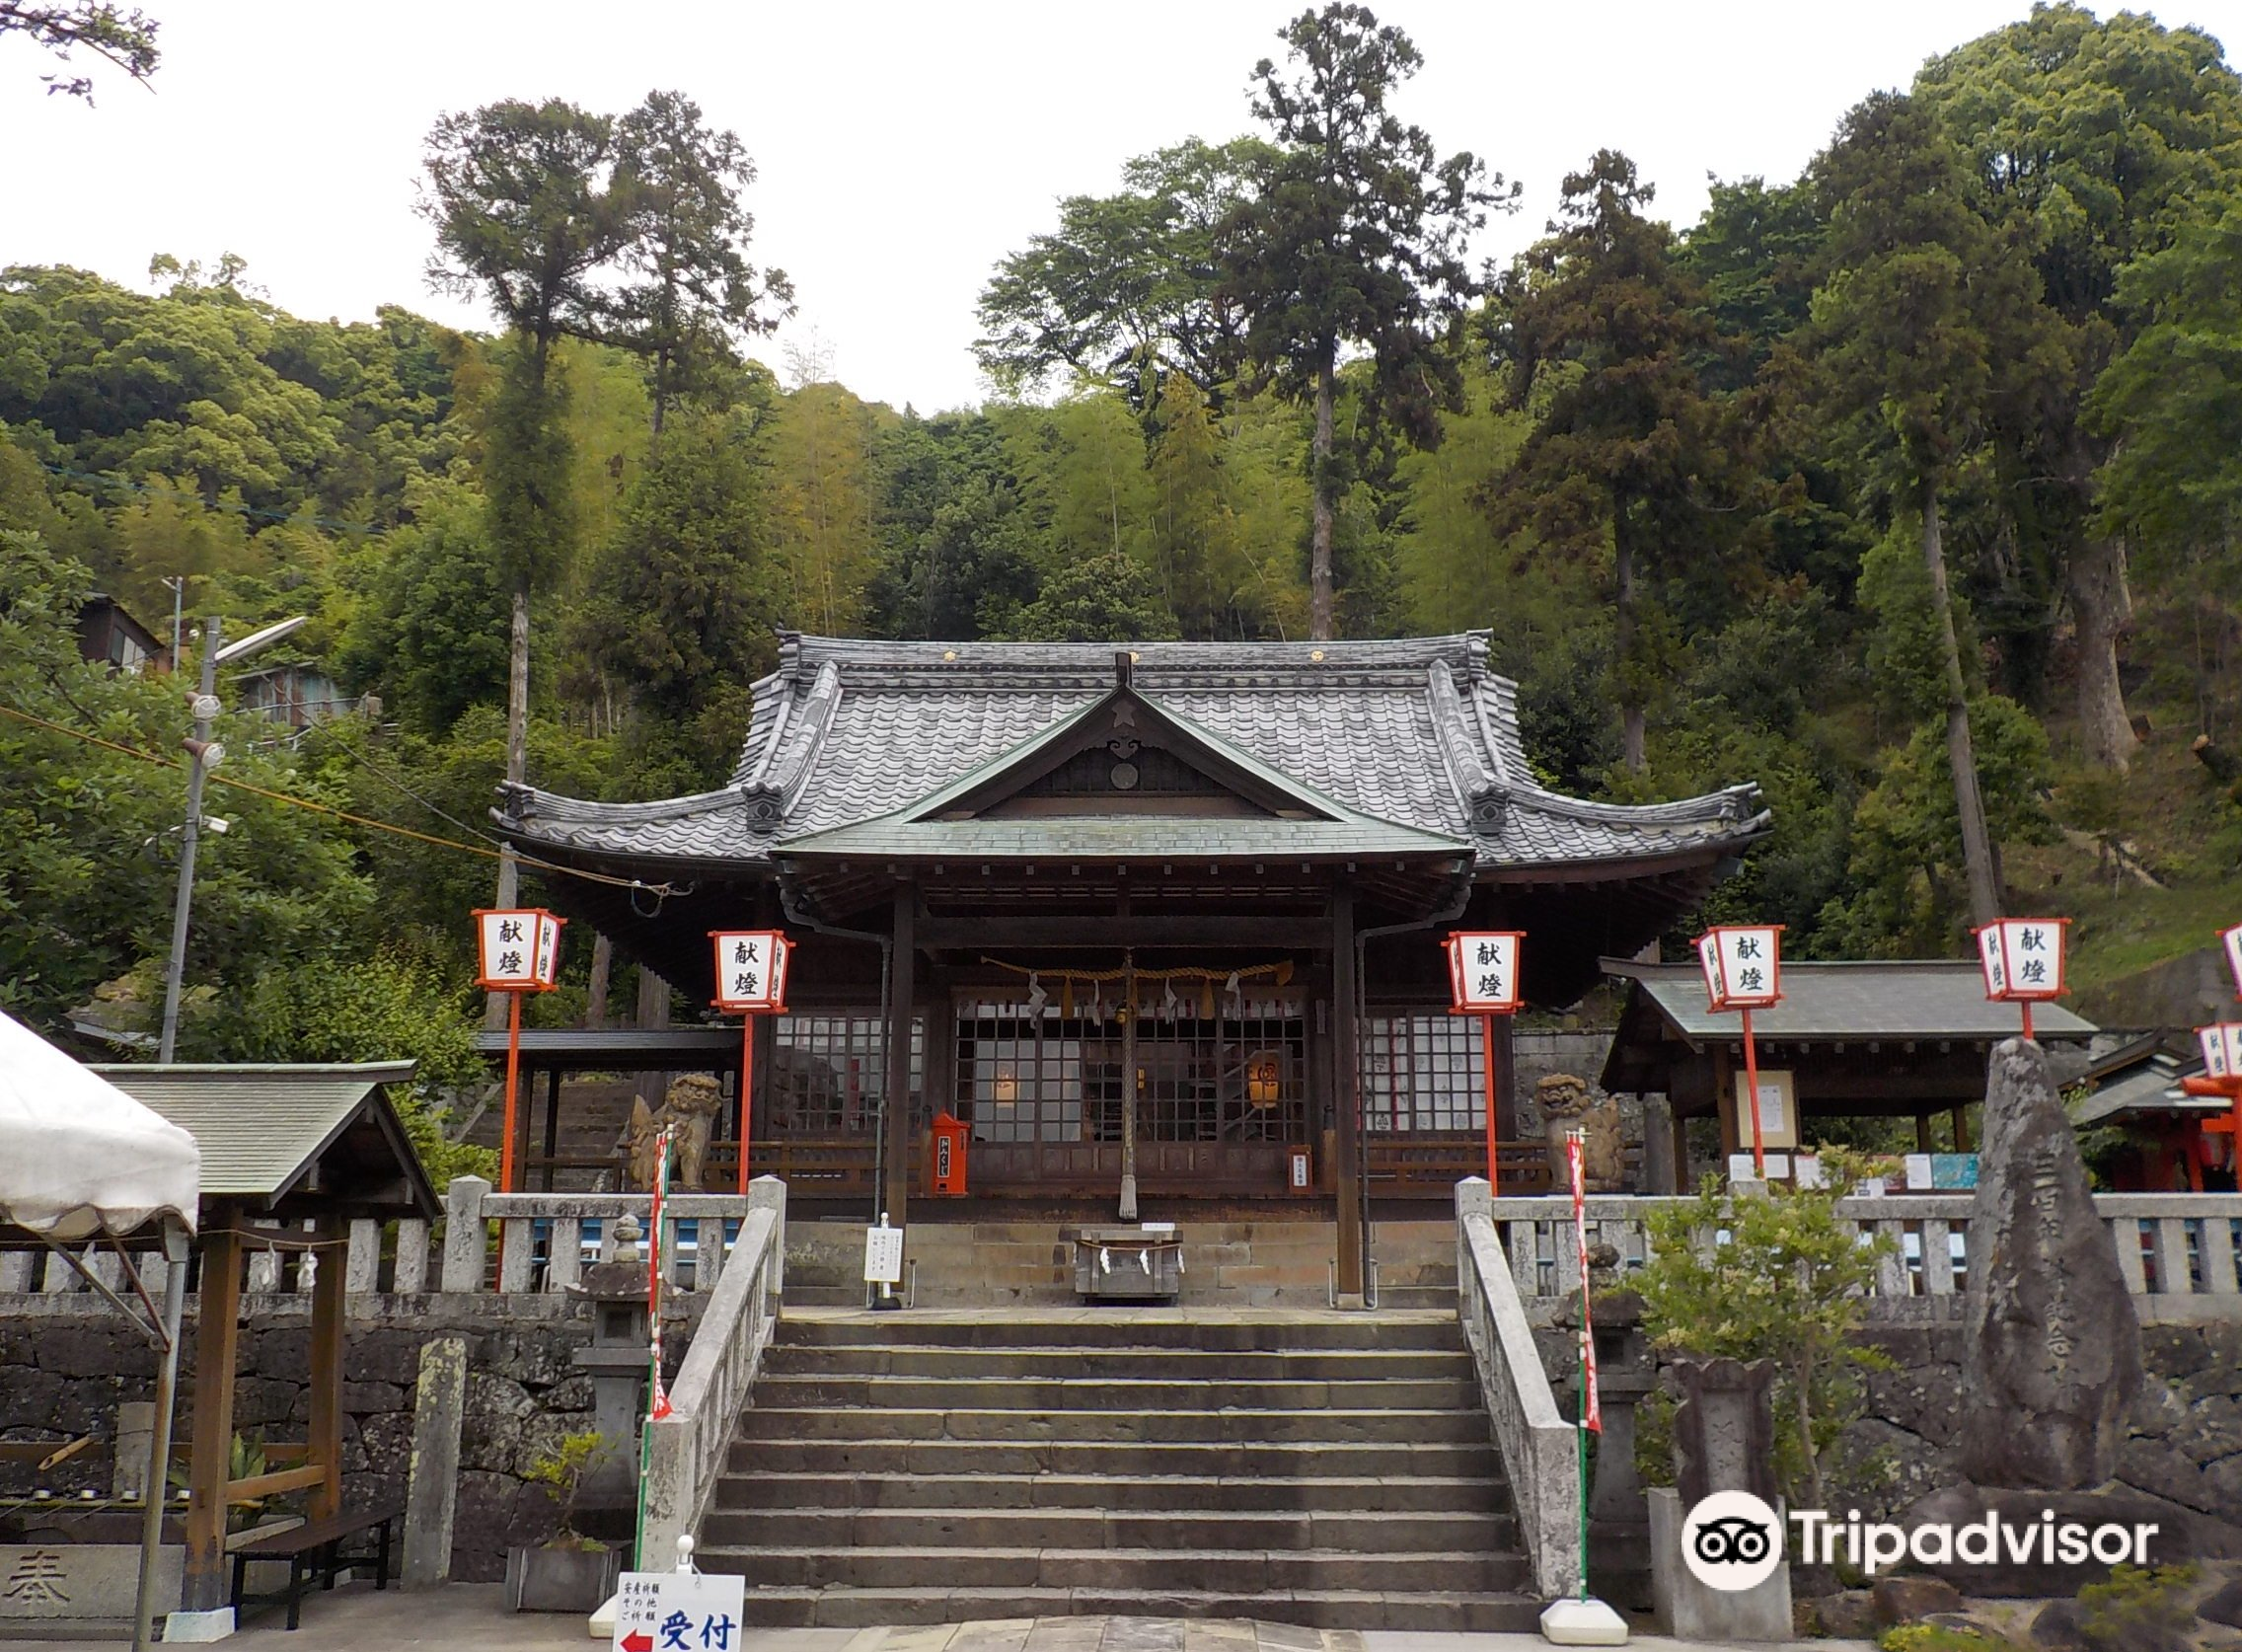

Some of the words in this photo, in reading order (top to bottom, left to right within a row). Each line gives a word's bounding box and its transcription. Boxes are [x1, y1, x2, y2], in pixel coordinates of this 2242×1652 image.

[497, 919, 523, 974] 献燈
[734, 940, 759, 996] 献燈
[1476, 941, 1502, 997] 献燈
[1736, 937, 1763, 991] 献燈
[2020, 927, 2047, 983] 献燈
[939, 1138, 949, 1176] おみくじ
[623, 1582, 660, 1596] 安産祈願
[623, 1598, 657, 1610] その他
[621, 1611, 657, 1622] ご祈願
[659, 1609, 737, 1651] 受付
